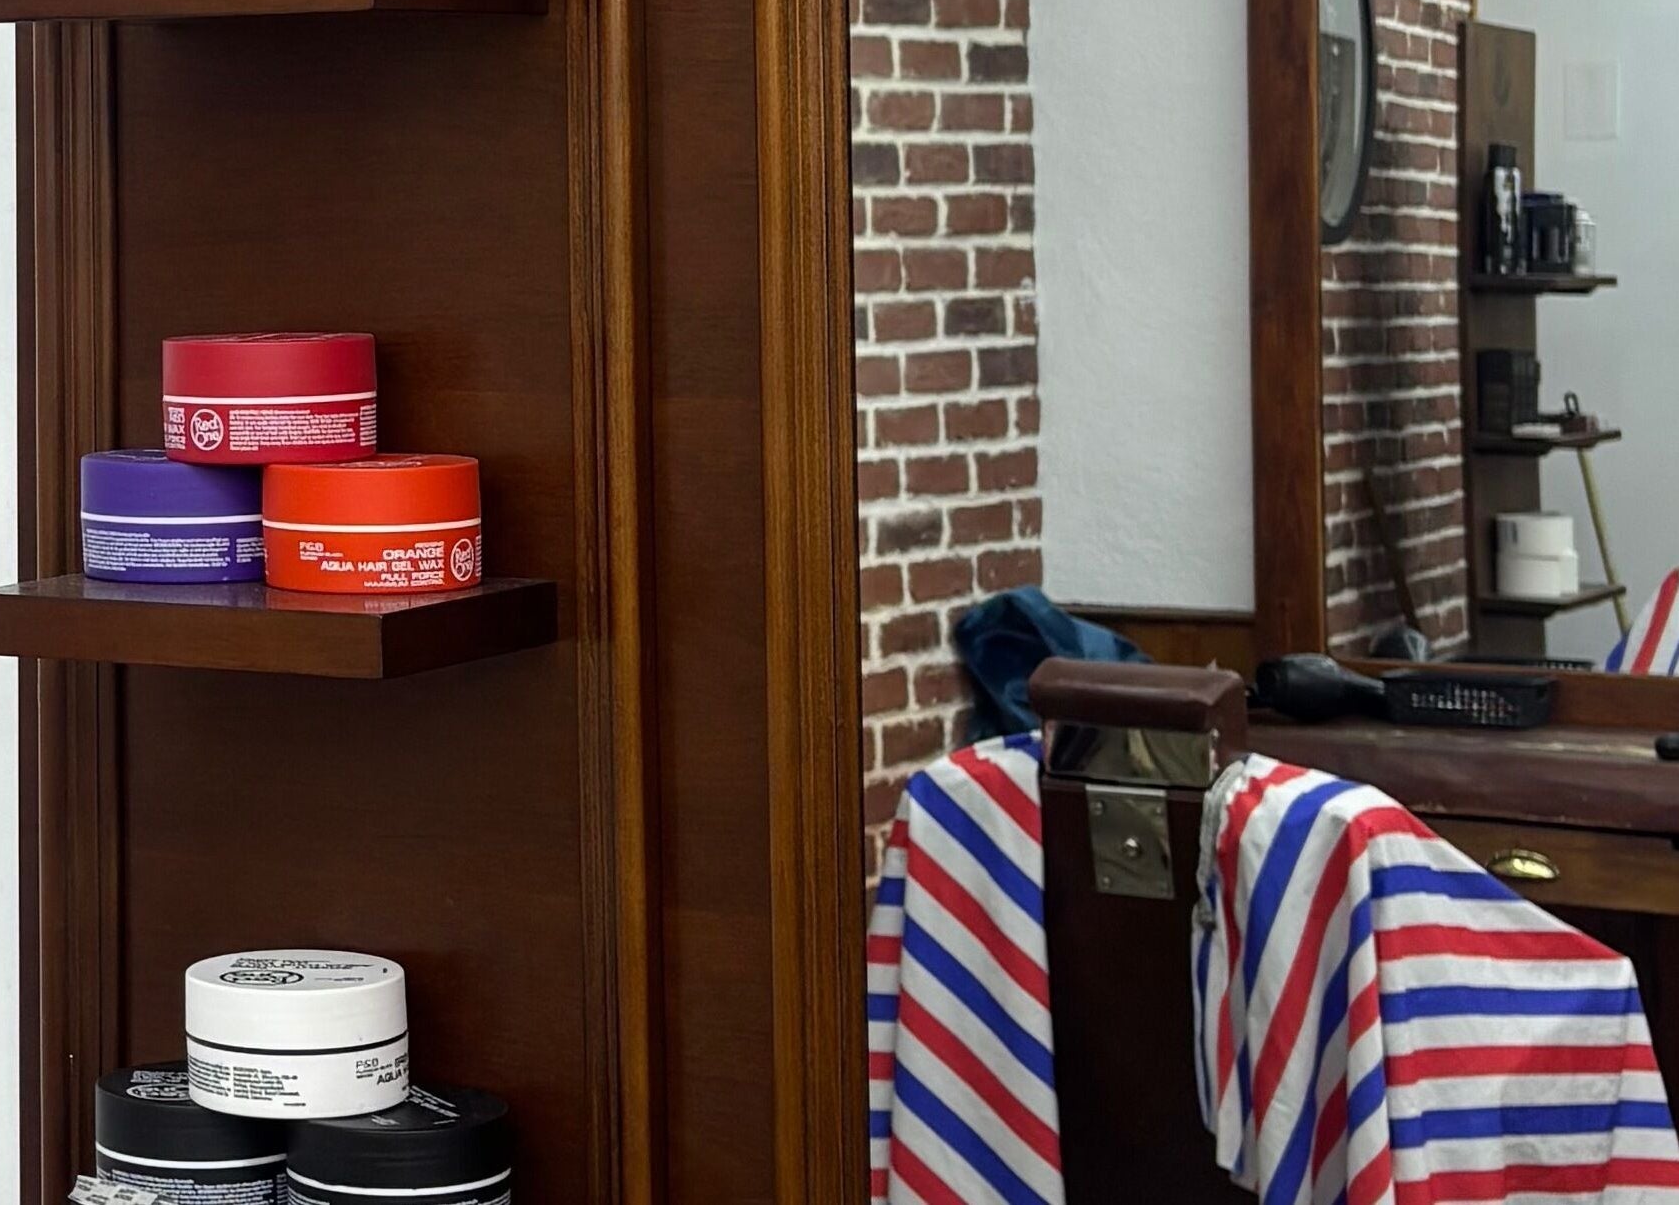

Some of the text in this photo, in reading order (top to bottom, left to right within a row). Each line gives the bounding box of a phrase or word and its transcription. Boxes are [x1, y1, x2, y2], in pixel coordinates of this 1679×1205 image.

[383, 548, 444, 560] ORANGE
[320, 559, 444, 572] AQUA HAIR GEL WAX
